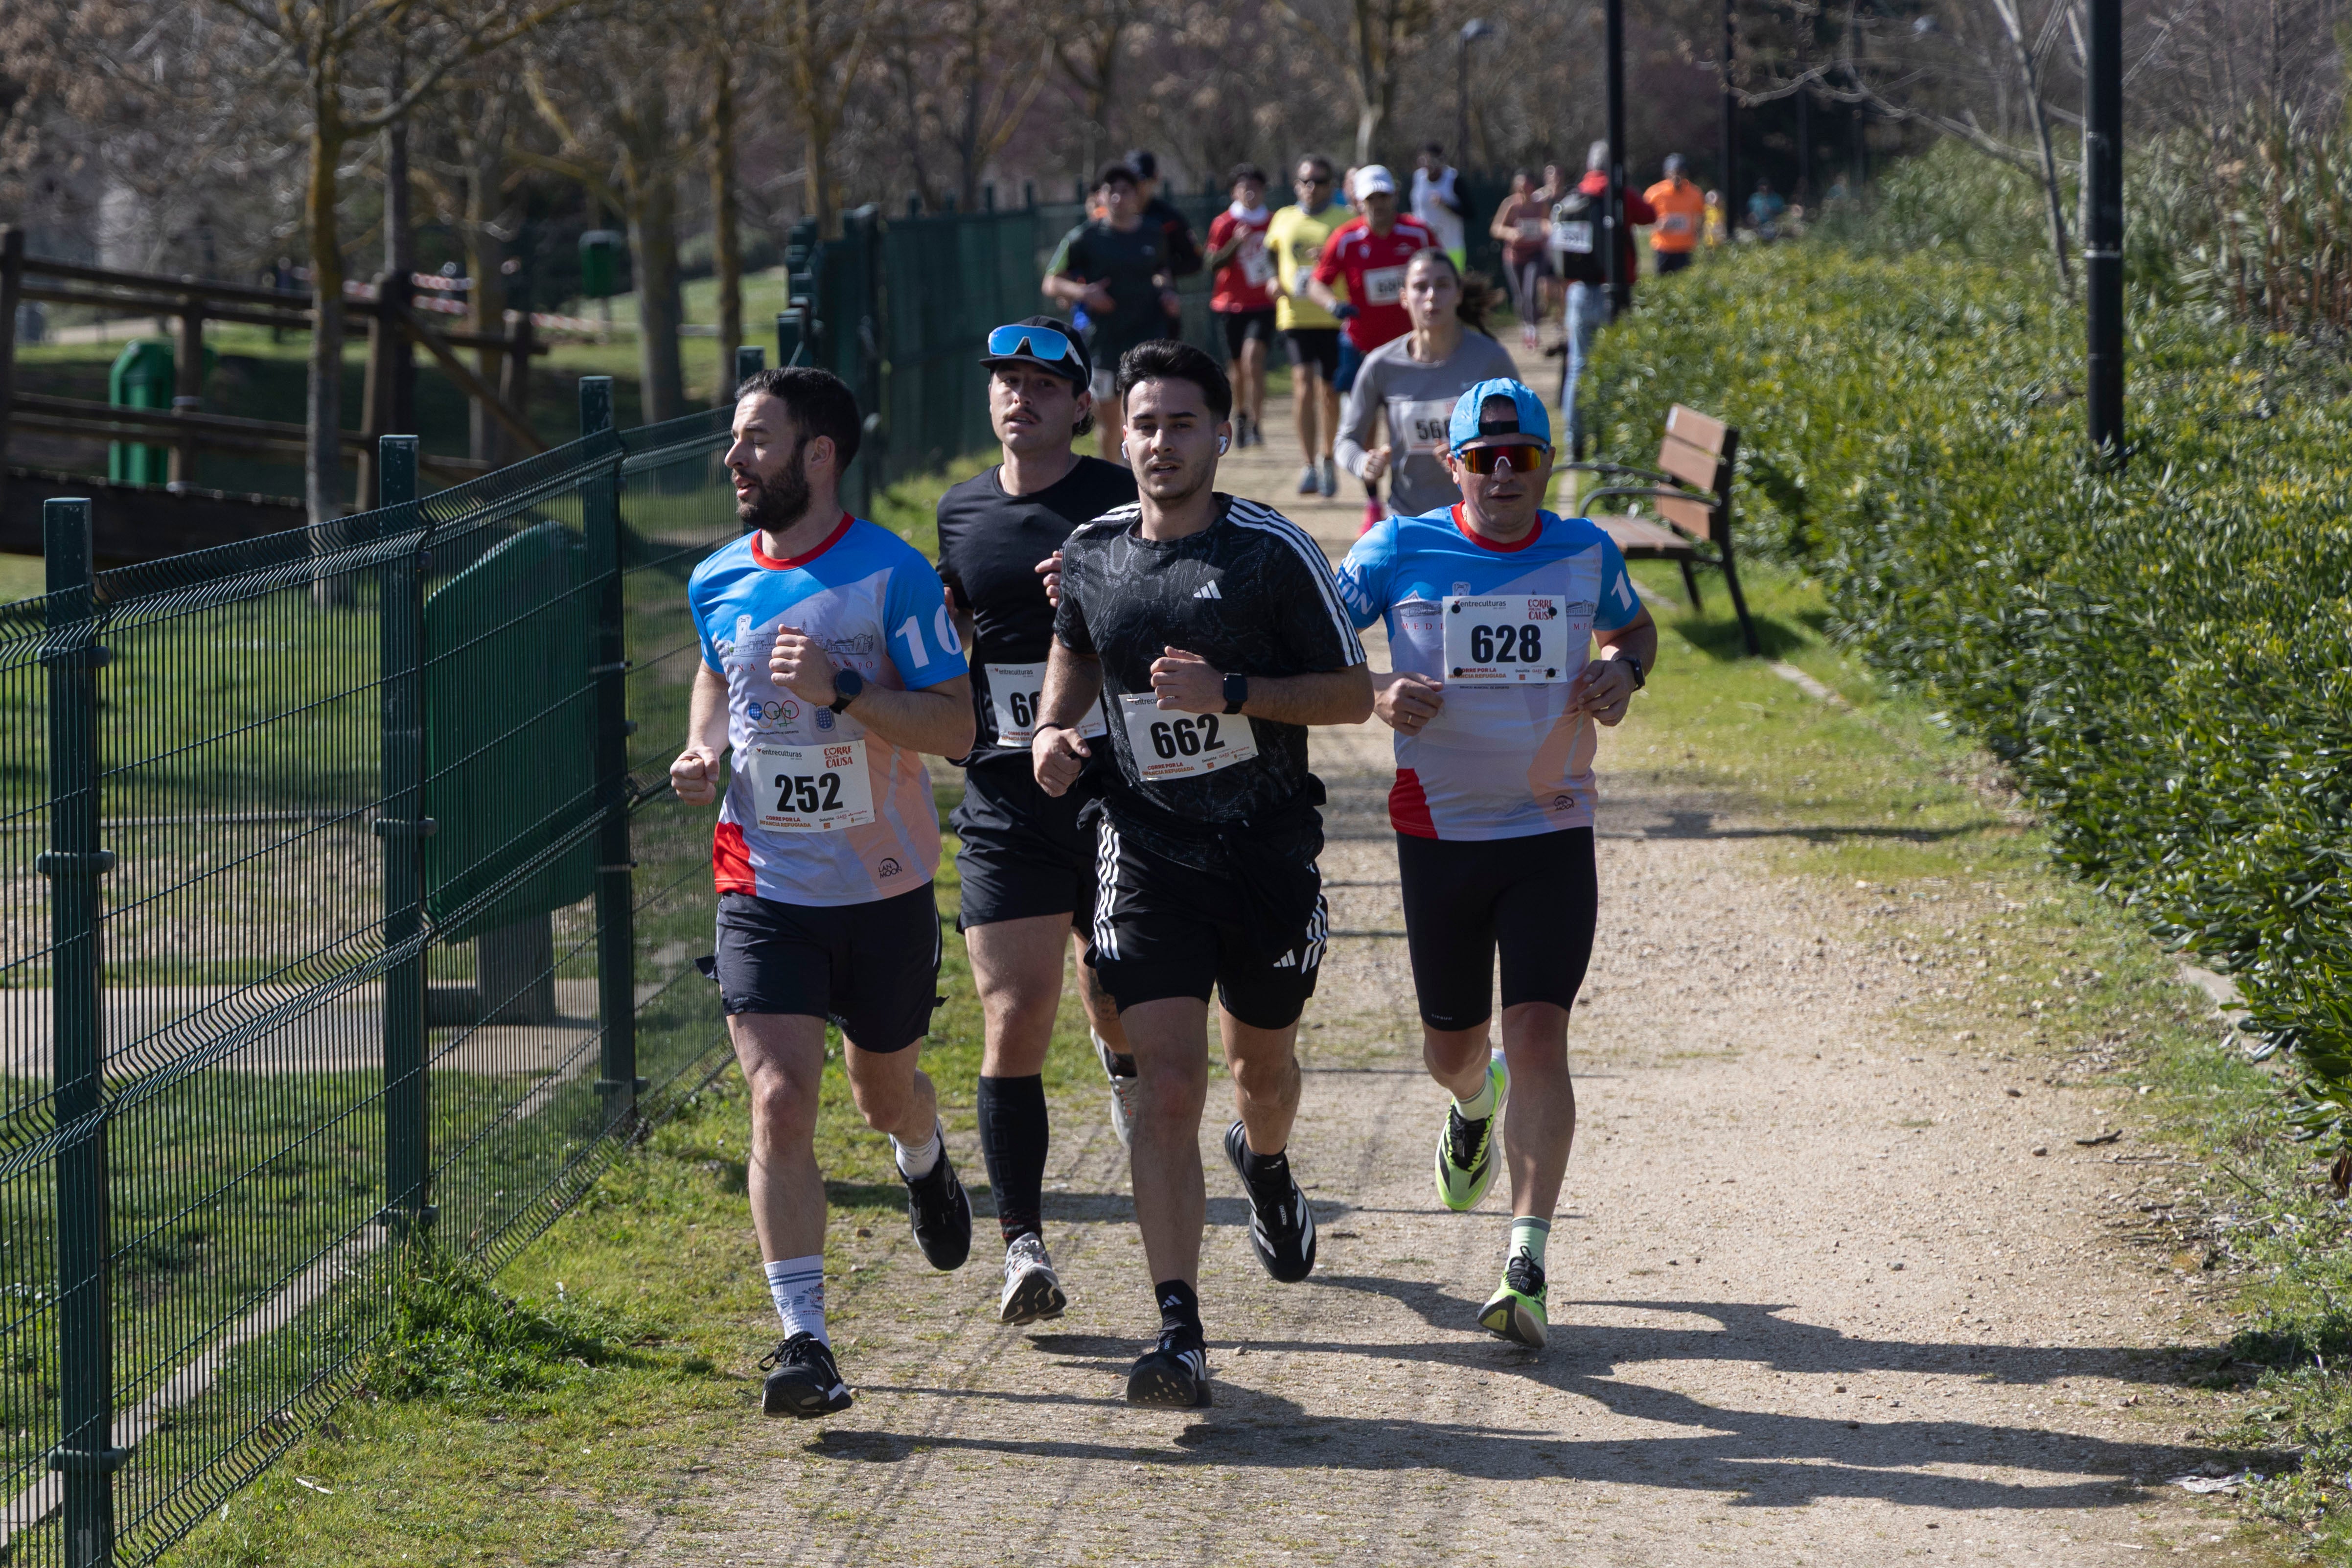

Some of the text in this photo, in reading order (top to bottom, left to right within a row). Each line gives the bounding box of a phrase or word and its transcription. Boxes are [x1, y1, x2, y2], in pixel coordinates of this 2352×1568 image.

[1528, 599, 1553, 609] CORRE
[1528, 611, 1554, 620] CAUSA
[895, 603, 963, 669] 10
[1471, 624, 1542, 663] 628
[831, 661, 873, 669] AMPO
[1151, 714, 1225, 759] 662
[761, 749, 802, 758] entreculturas
[824, 745, 853, 756] CORRE
[826, 756, 853, 768] CAUSA
[775, 772, 843, 813] 252
[878, 863, 892, 873] LAN
[879, 866, 902, 879] MOON
